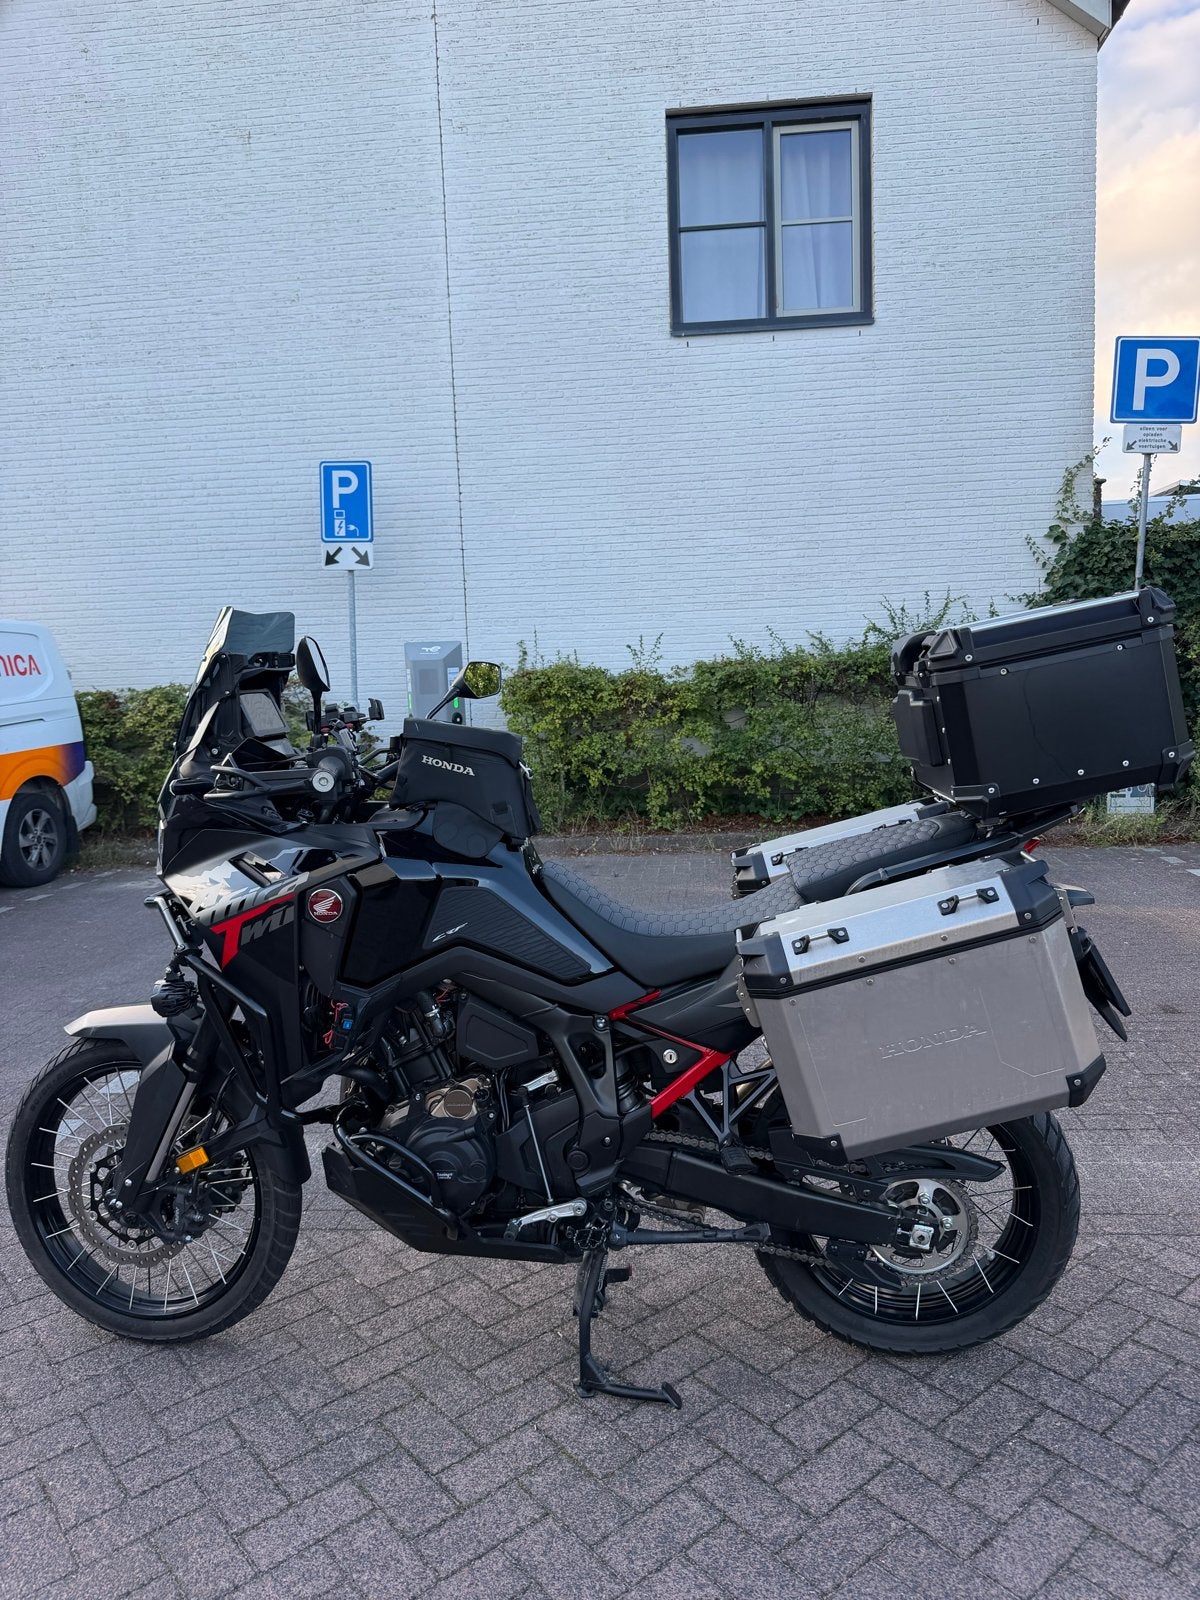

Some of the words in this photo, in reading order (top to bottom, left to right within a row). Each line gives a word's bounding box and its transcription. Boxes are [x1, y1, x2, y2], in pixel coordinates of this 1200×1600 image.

[1132, 348, 1181, 411] P
[331, 470, 359, 509] P
[421, 754, 476, 777] HONDA
[879, 1024, 988, 1059] HONDA
